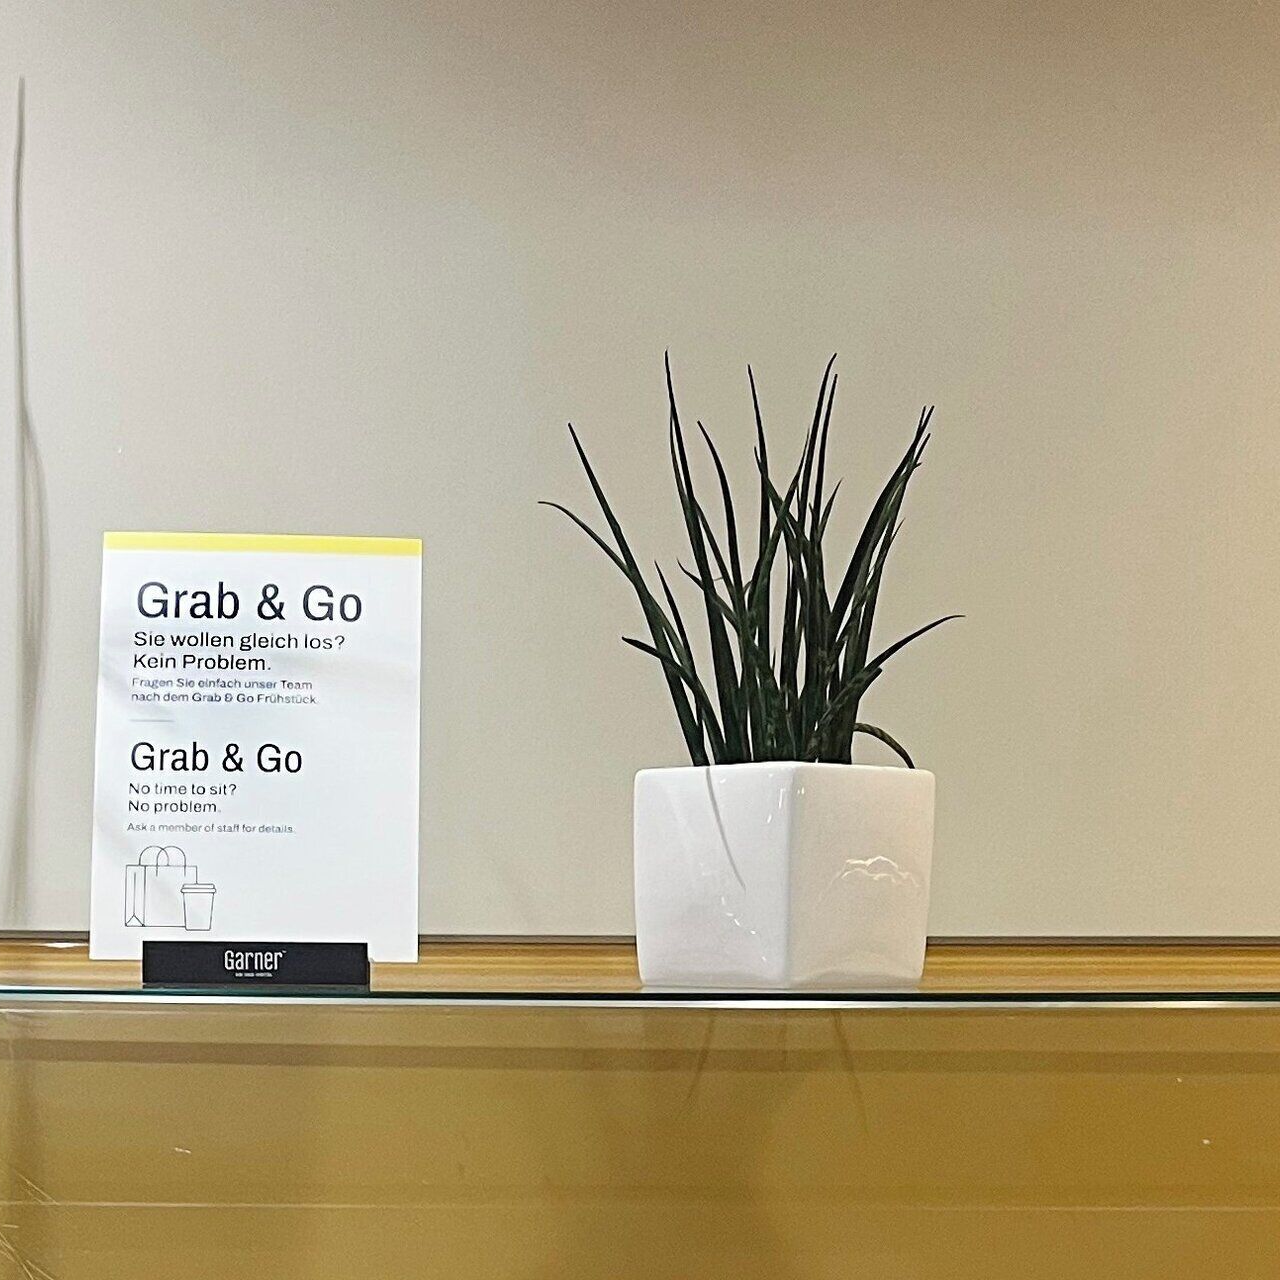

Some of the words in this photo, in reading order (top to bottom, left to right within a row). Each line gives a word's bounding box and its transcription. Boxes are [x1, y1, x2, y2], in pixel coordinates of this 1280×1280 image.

[136, 581, 241, 620] Grab
[256, 583, 286, 621] &
[303, 584, 363, 622] Go
[134, 631, 166, 647] Sie
[170, 632, 234, 647] wollen
[239, 633, 298, 651] gleich
[304, 634, 345, 650] los?
[133, 653, 176, 669] Kein
[183, 654, 271, 671] Problem.
[132, 677, 173, 690] Fragen
[176, 678, 195, 689] Sie
[198, 678, 241, 689] einfach
[244, 680, 277, 689] unser
[281, 680, 313, 690] Team
[131, 692, 160, 702] nach
[163, 692, 189, 702] dem
[192, 692, 221, 703] Grab
[236, 693, 254, 703] Go
[130, 741, 210, 772] Grab
[222, 743, 244, 773] &
[256, 744, 303, 774] Go
[128, 782, 150, 795] No
[154, 783, 187, 795] time
[191, 783, 206, 795] to
[209, 783, 237, 796] sit?
[128, 800, 150, 812] No
[154, 800, 221, 814] problem.
[127, 822, 147, 832] Ask
[158, 823, 202, 832] member
[204, 823, 215, 832] of
[217, 823, 240, 833] staff
[242, 823, 256, 833] for
[224, 950, 283, 971] Garner
